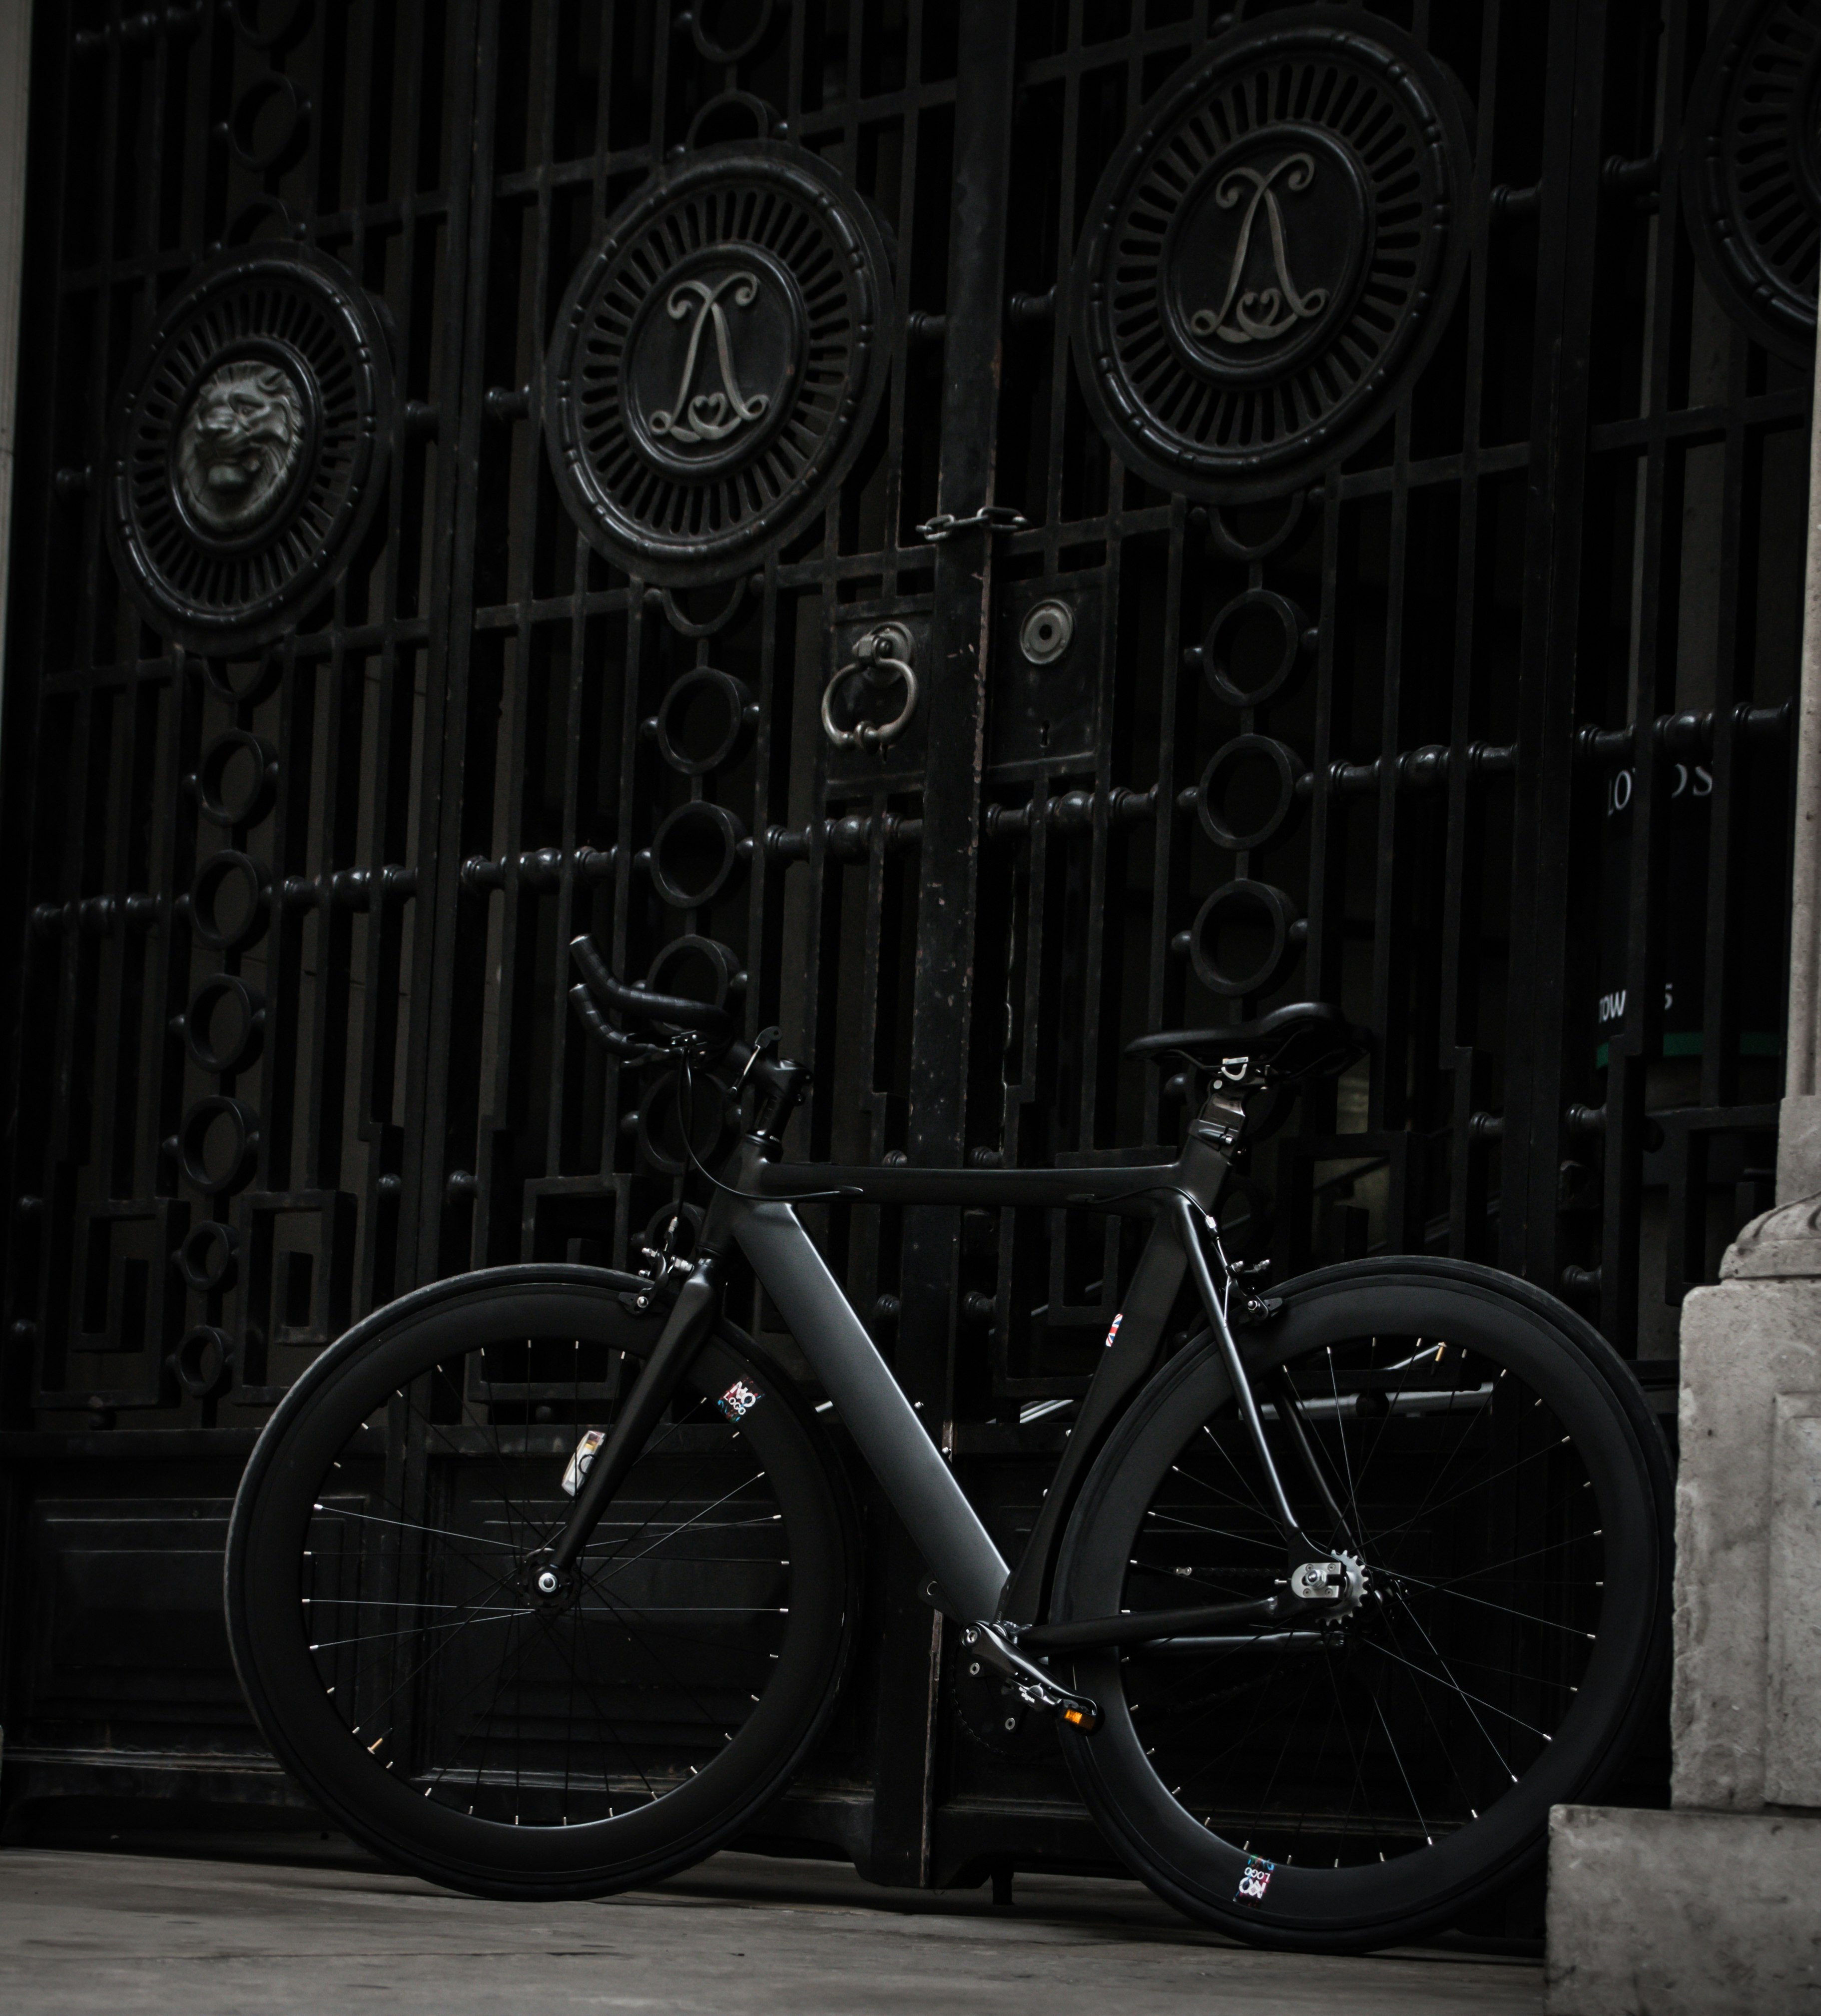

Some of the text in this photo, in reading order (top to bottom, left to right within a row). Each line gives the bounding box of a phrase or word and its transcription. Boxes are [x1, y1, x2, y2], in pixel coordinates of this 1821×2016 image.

[723, 1392, 746, 1415] LOGO
[730, 1381, 756, 1408] NO
[1244, 1867, 1270, 1882] LOGO
[1239, 1877, 1266, 1899] NO
